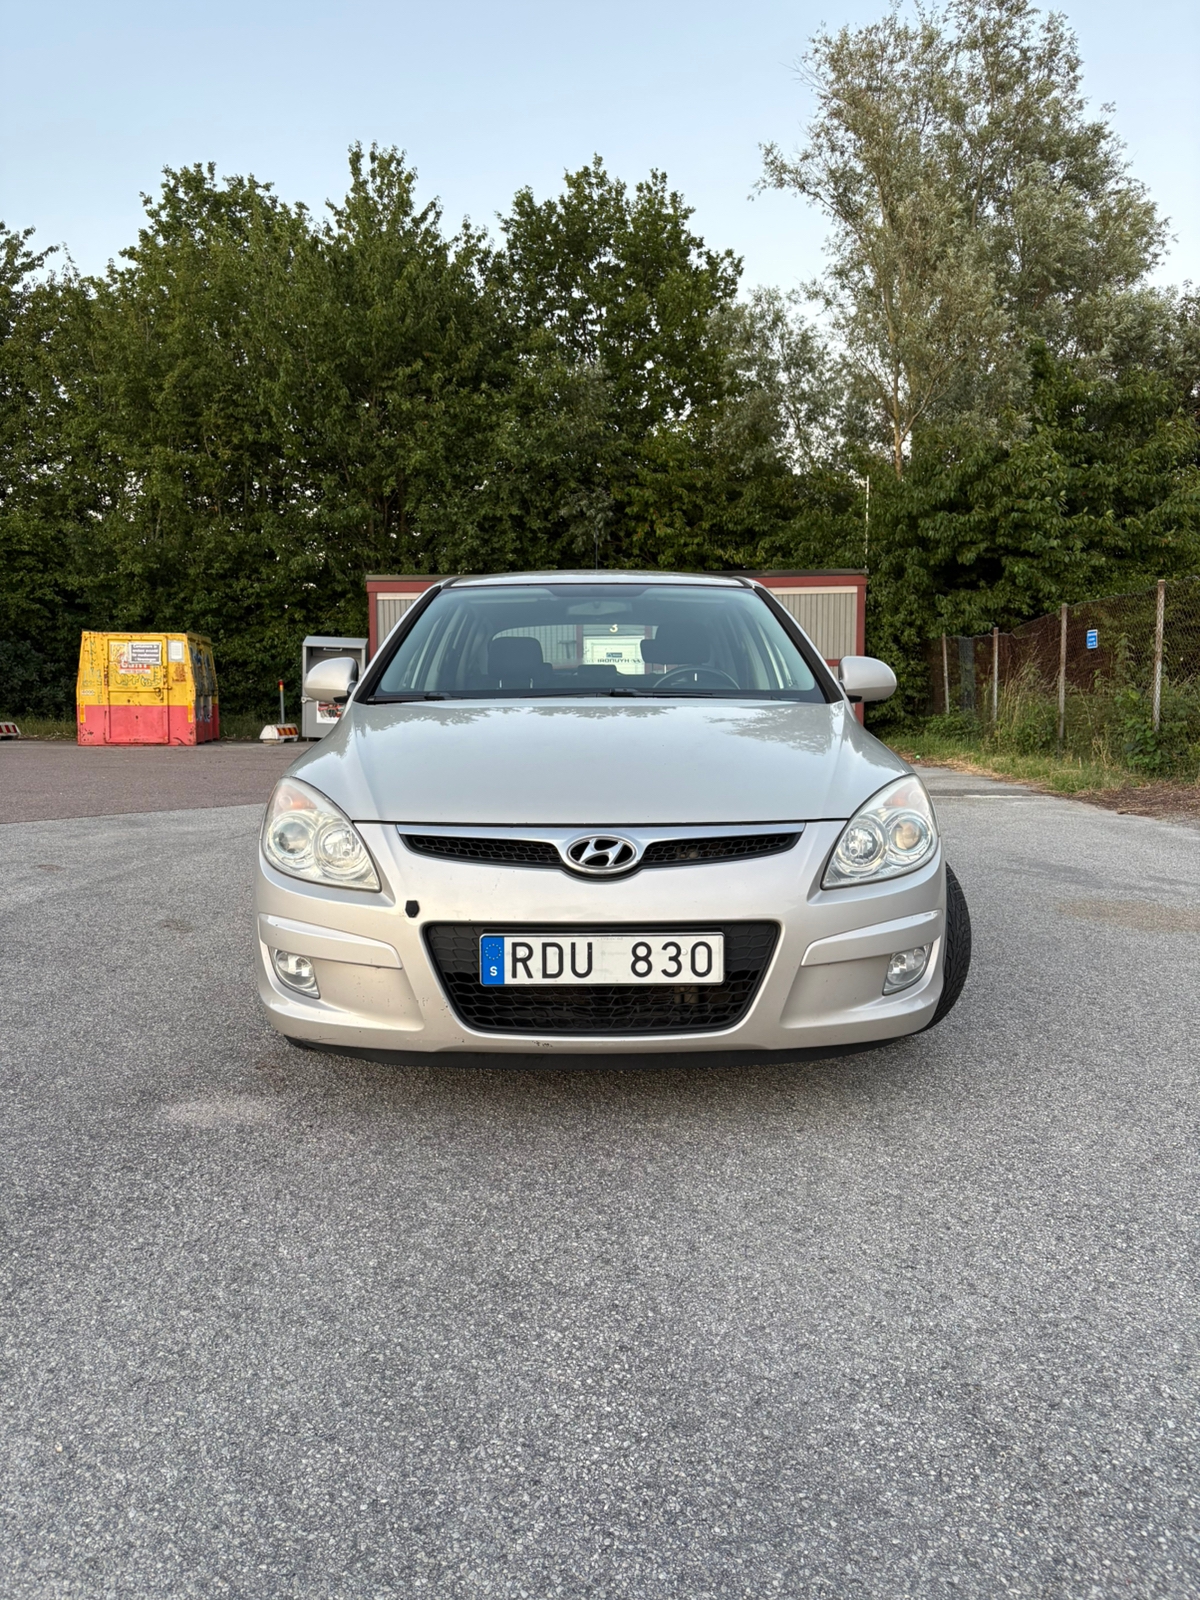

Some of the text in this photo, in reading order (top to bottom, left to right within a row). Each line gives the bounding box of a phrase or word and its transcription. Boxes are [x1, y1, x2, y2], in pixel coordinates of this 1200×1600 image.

[490, 966, 498, 977] S
[510, 941, 713, 979] RDU 830
